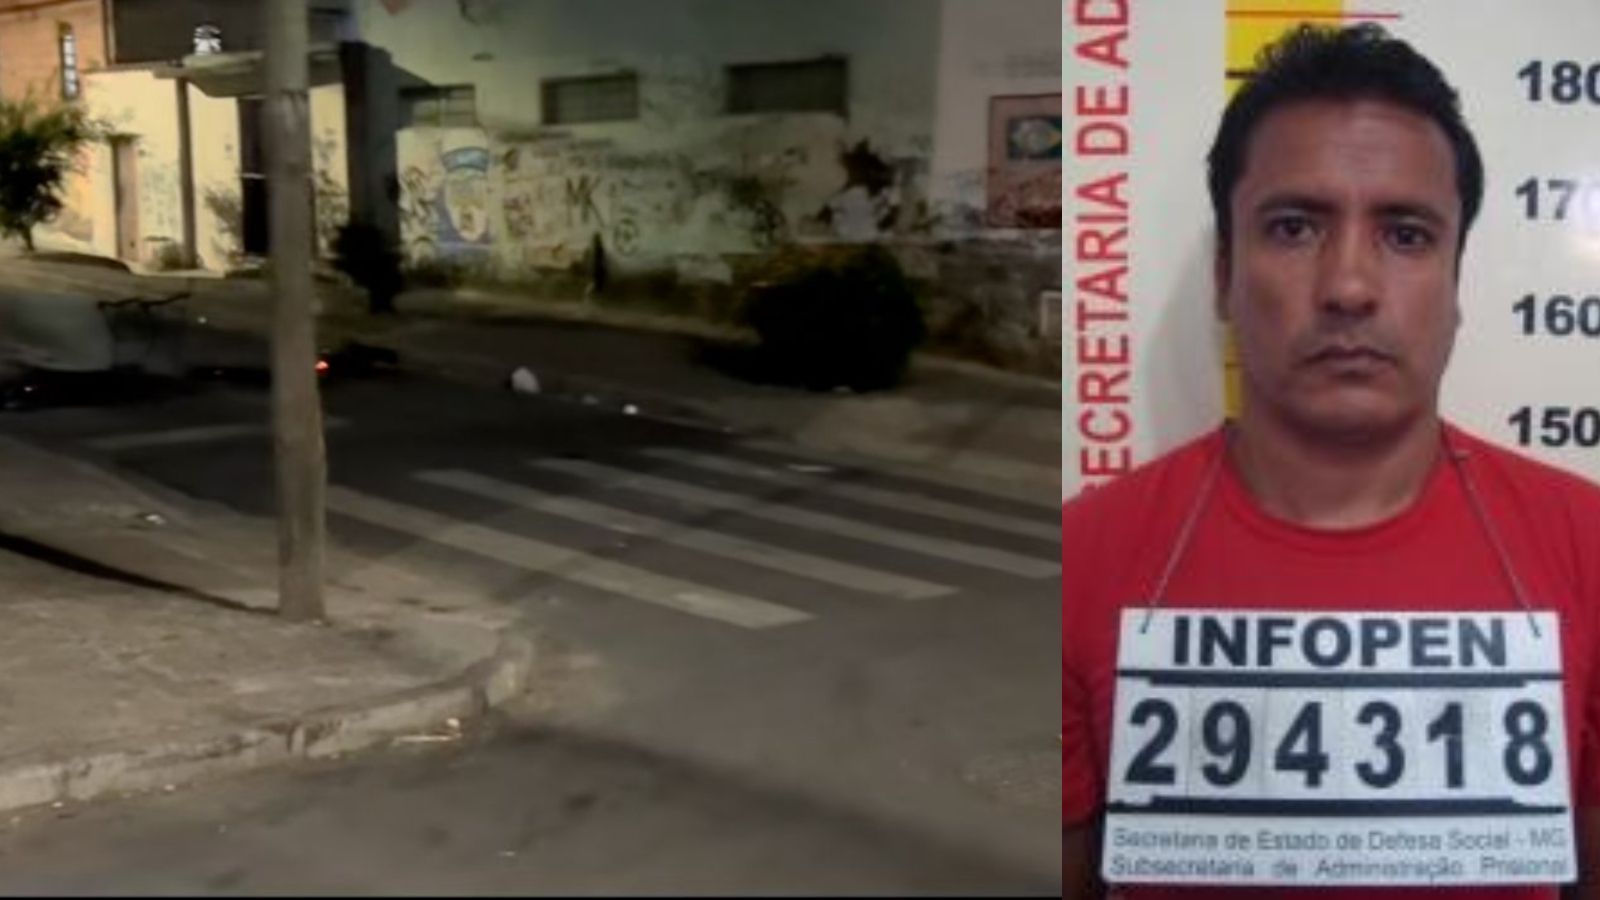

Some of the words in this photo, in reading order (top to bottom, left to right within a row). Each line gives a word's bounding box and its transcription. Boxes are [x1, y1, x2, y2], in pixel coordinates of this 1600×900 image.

[1076, 86, 1128, 155] DE
[1515, 177, 1600, 220] 17
[1512, 294, 1600, 336] 160
[1509, 406, 1600, 447] 150
[1172, 616, 1507, 668] INFOPEN
[1124, 699, 1553, 789] 294318
[1224, 832, 1250, 849] de
[1257, 829, 1330, 850] Estado
[1336, 832, 1362, 850] de
